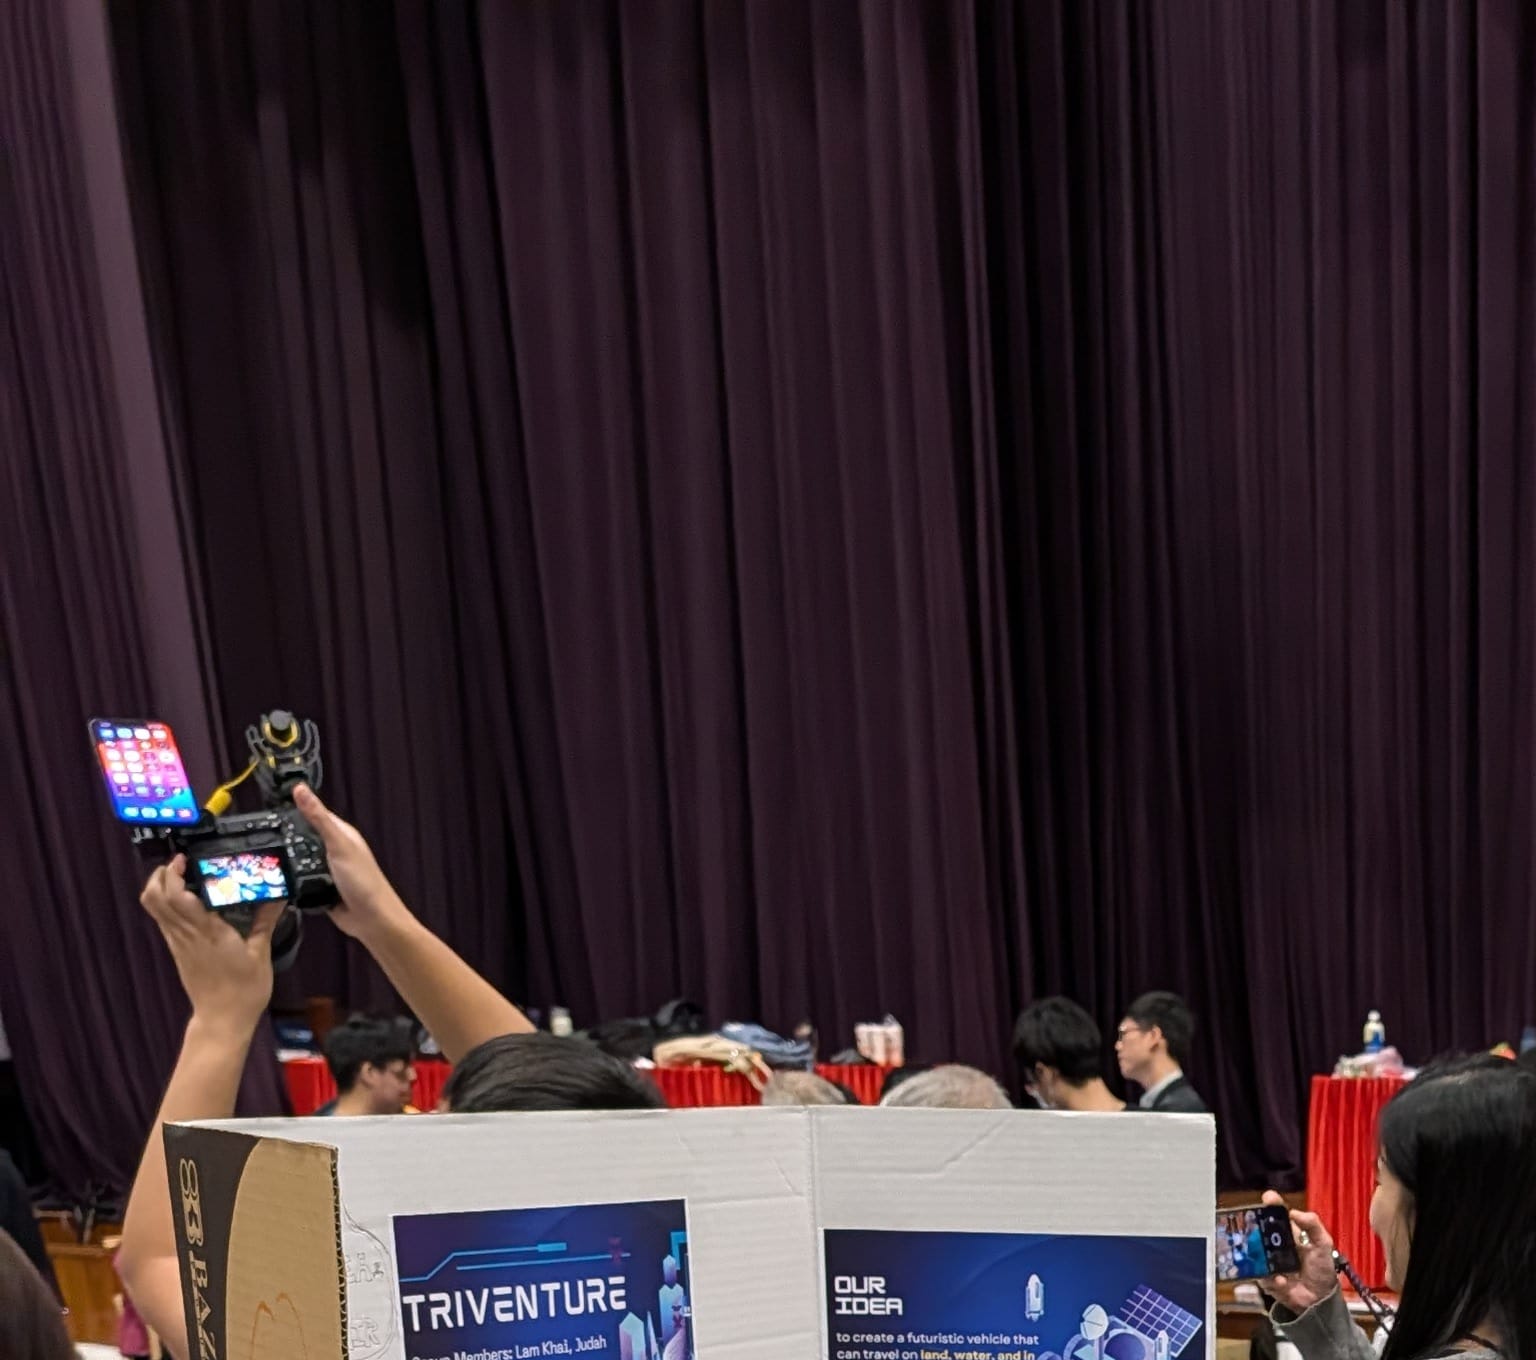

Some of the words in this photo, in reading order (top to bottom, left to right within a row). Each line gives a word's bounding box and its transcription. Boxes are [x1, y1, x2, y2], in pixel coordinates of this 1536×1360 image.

[834, 1275, 886, 1295] OUR
[402, 1276, 627, 1332] TRIVENTURE
[835, 1297, 903, 1316] IDEA
[515, 1345, 540, 1360] Lam
[541, 1339, 573, 1356] Khai,
[575, 1334, 607, 1352] Judah
[836, 1332, 851, 1343] to
[852, 1333, 895, 1343] create
[896, 1334, 905, 1343] a
[906, 1332, 964, 1344] futuristic
[966, 1333, 1011, 1345] vehicle
[1013, 1334, 1039, 1345] that
[836, 1350, 861, 1360] can
[863, 1349, 899, 1360] travel
[901, 1351, 919, 1360] on
[1023, 1350, 1035, 1360] in
